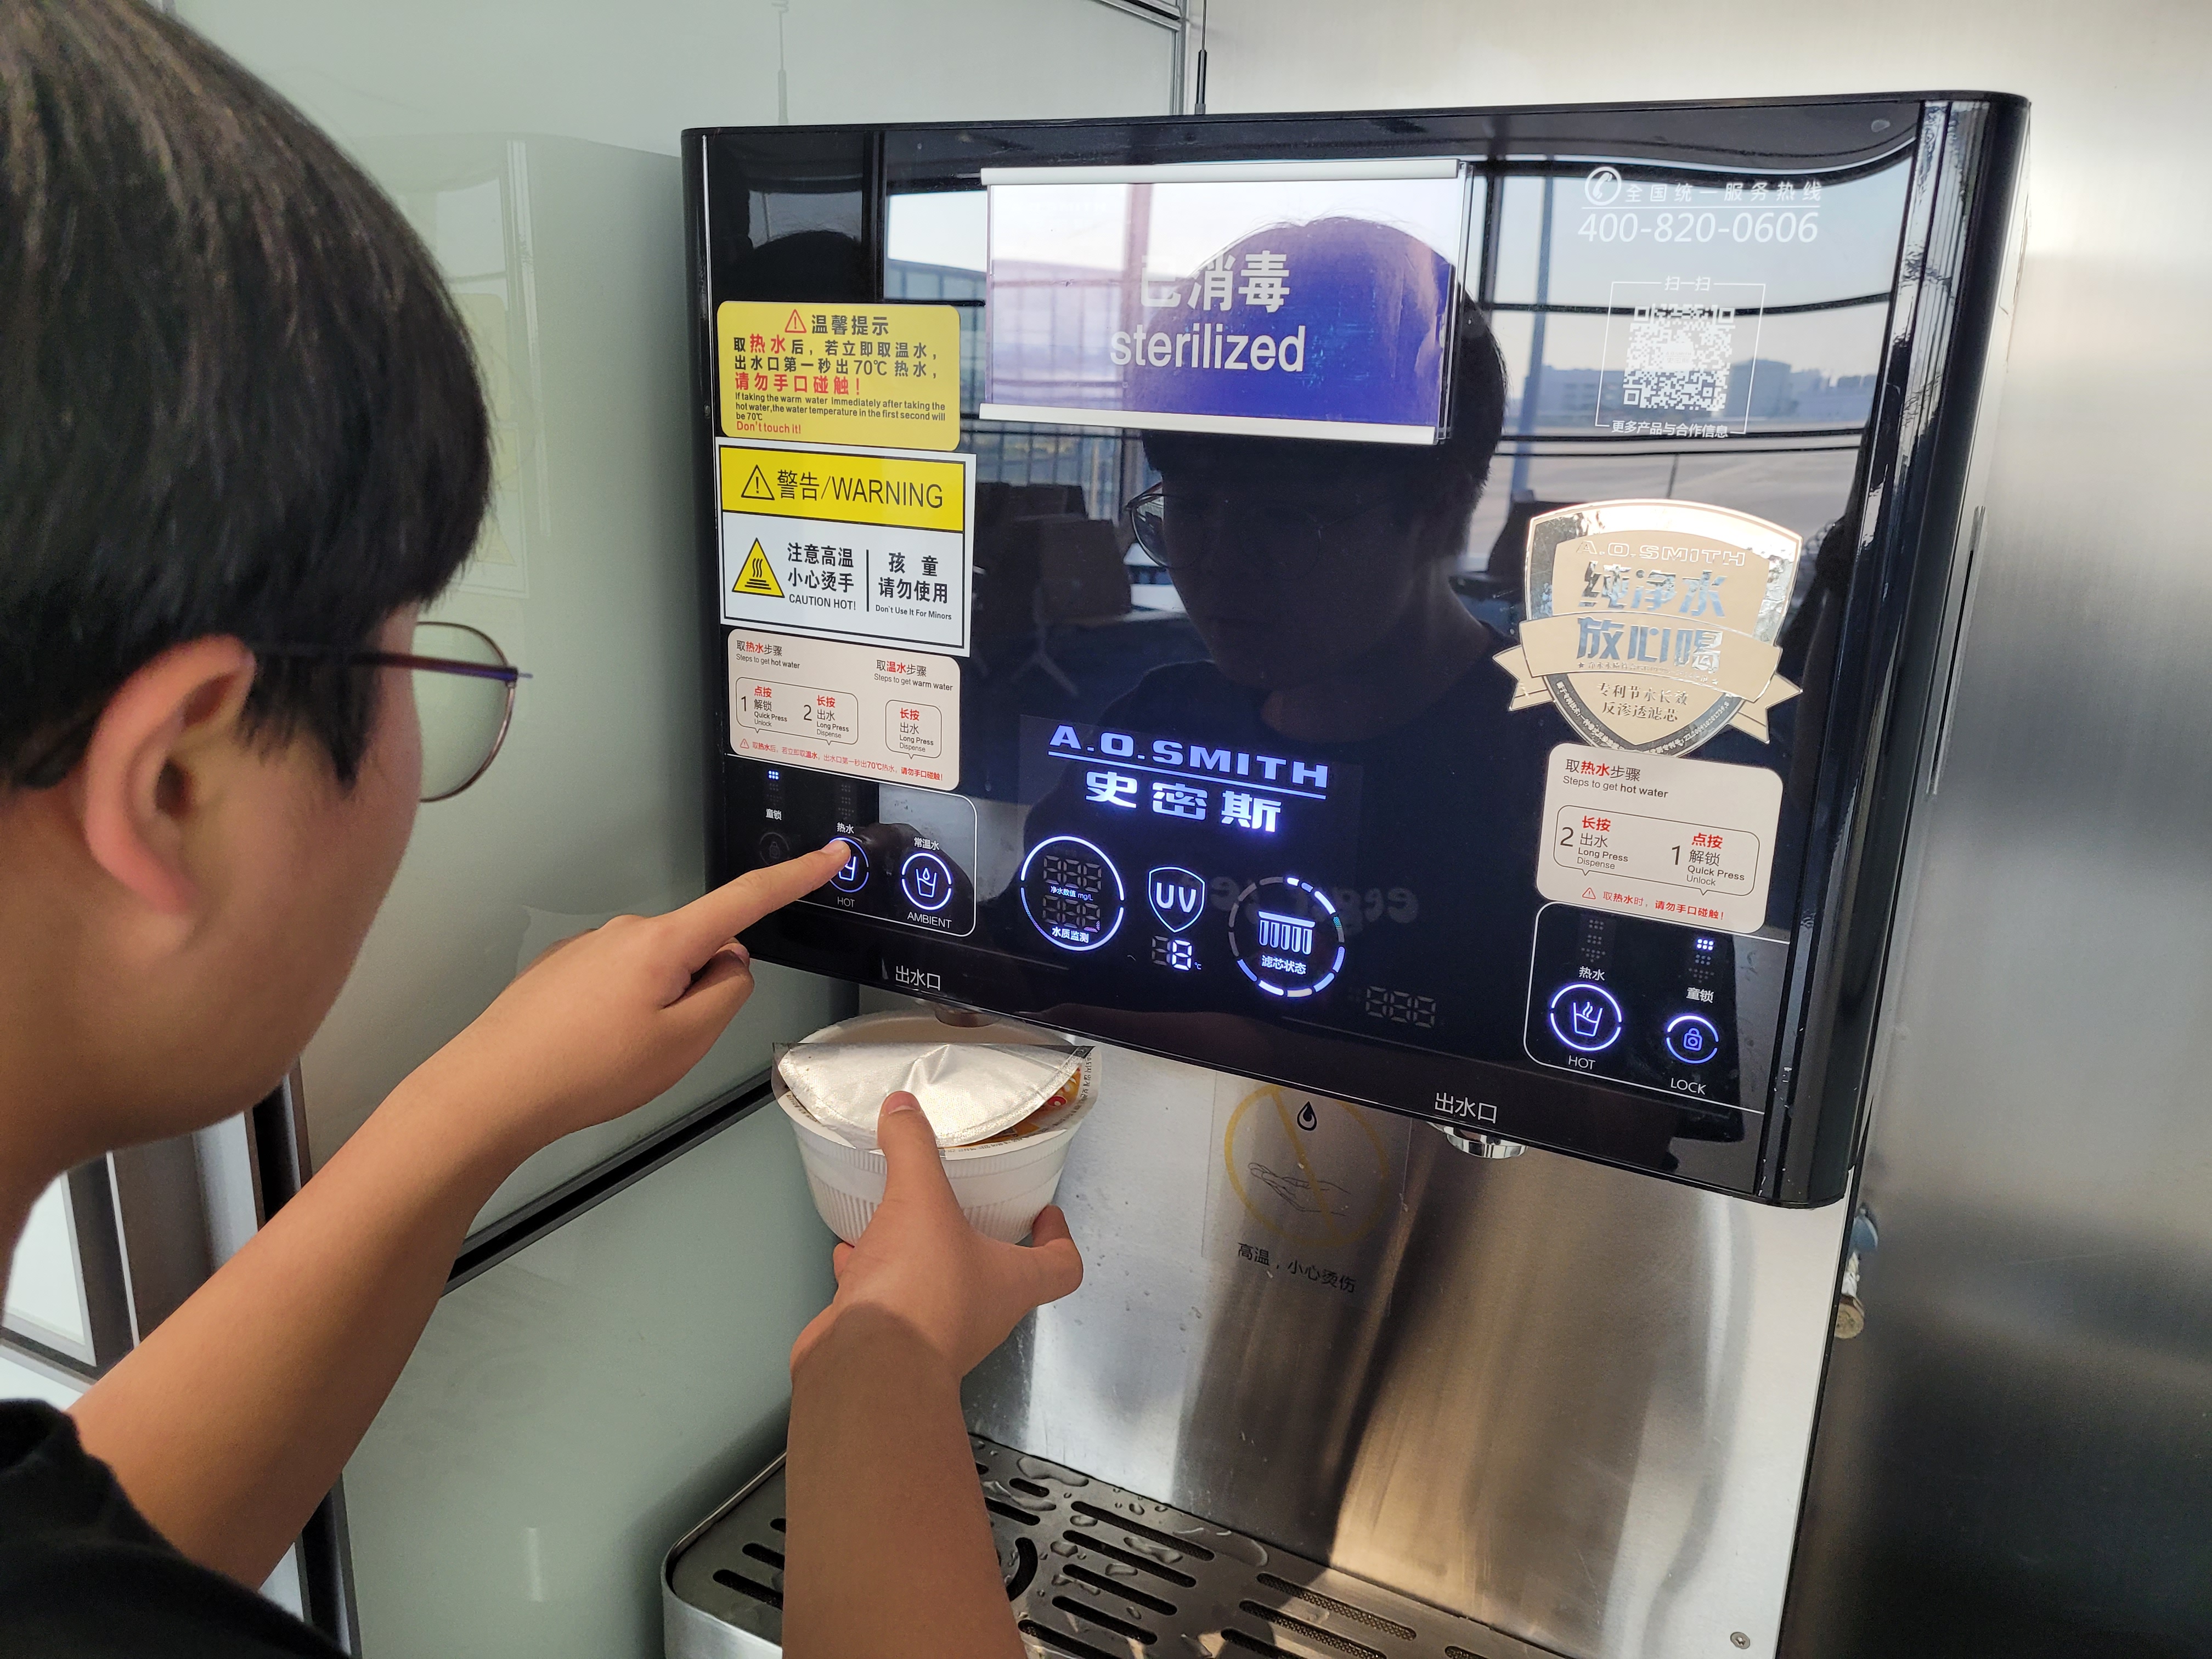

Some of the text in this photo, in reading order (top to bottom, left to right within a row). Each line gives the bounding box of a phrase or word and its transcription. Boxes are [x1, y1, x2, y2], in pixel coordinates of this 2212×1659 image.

[1626, 181, 1822, 202] 全国统一服务热线
[1578, 212, 1819, 242] 400-820-0606
[1664, 276, 1711, 291] 扫一扫
[811, 315, 889, 335] 温馨提示
[1110, 324, 1306, 372] sterilized
[736, 402, 747, 410] hot
[809, 406, 857, 416] temperature
[859, 409, 866, 417] in
[742, 393, 765, 402] taking
[831, 397, 881, 409] immediately
[883, 400, 902, 408] after
[905, 400, 929, 410] taking
[932, 402, 945, 410] the
[737, 421, 761, 432] Don't
[764, 423, 789, 433] touch
[1612, 420, 1728, 438] 更多产品与合作信息
[787, 542, 854, 568] 注意高温
[1576, 540, 1745, 566] A.O.SMITH
[788, 567, 854, 593] 小心烫手
[878, 577, 948, 604] 请勿使用
[1578, 561, 1728, 618] 纯净水
[789, 594, 856, 611] CAUTION HOT!
[895, 606, 907, 616] Use
[909, 607, 914, 616] It
[916, 608, 927, 617] For
[928, 610, 952, 620] Minors
[737, 640, 782, 657] 取热水步骤
[1576, 617, 1723, 674] 放心喝
[736, 654, 752, 663] Steps
[877, 659, 927, 677] 取温水步骤
[874, 674, 891, 682] Steps
[913, 680, 932, 688] warm
[933, 682, 953, 691] water
[754, 686, 772, 698] 点按
[1598, 682, 1689, 706] 专利节水长效
[741, 696, 747, 712] 1
[754, 699, 772, 712] 解锁
[817, 695, 835, 708] 长按
[804, 705, 812, 721] 2
[817, 709, 835, 721] 出水
[900, 708, 919, 721] 长按
[1602, 701, 1678, 722] 反渗透滤芯
[817, 721, 849, 732] Long Press
[817, 729, 841, 738] Dispense
[900, 722, 919, 734] 出水
[900, 735, 933, 746] Long Press
[900, 742, 926, 752] Dispense
[1049, 725, 1328, 789] A.O.SMITH
[1565, 759, 1641, 781] 取热水步骤
[1563, 776, 1668, 798] Steps to get hot water
[1085, 771, 1282, 832] 史密斯
[765, 809, 782, 820] 童锁
[837, 822, 854, 834] 热水
[1582, 816, 1611, 832] 长按
[914, 837, 940, 850] 常温水
[1560, 827, 1574, 847] 2
[1580, 833, 1609, 848] 出水
[1692, 833, 1723, 849] 点按
[1578, 847, 1628, 862] Long Press
[1672, 845, 1681, 865] 1
[1689, 849, 1719, 867] 解锁
[1577, 857, 1615, 870] Dispense
[1686, 875, 1716, 887] Unlock
[1688, 865, 1745, 881] Quick Press
[1050, 886, 1093, 901] 净水数值 mg/L
[1156, 882, 1197, 913] UV
[837, 896, 855, 908] HOT
[907, 911, 952, 928] AMBIENT
[1052, 927, 1089, 944] 水质监测
[1261, 955, 1307, 975] 滤芯状态
[895, 966, 941, 991] 出水口
[1579, 966, 1605, 981] 热水
[1686, 987, 1714, 1003] 童锁
[1568, 1055, 1595, 1070] HOT
[1671, 1077, 1706, 1095] LOCK
[1435, 1092, 1497, 1124] 出水口
